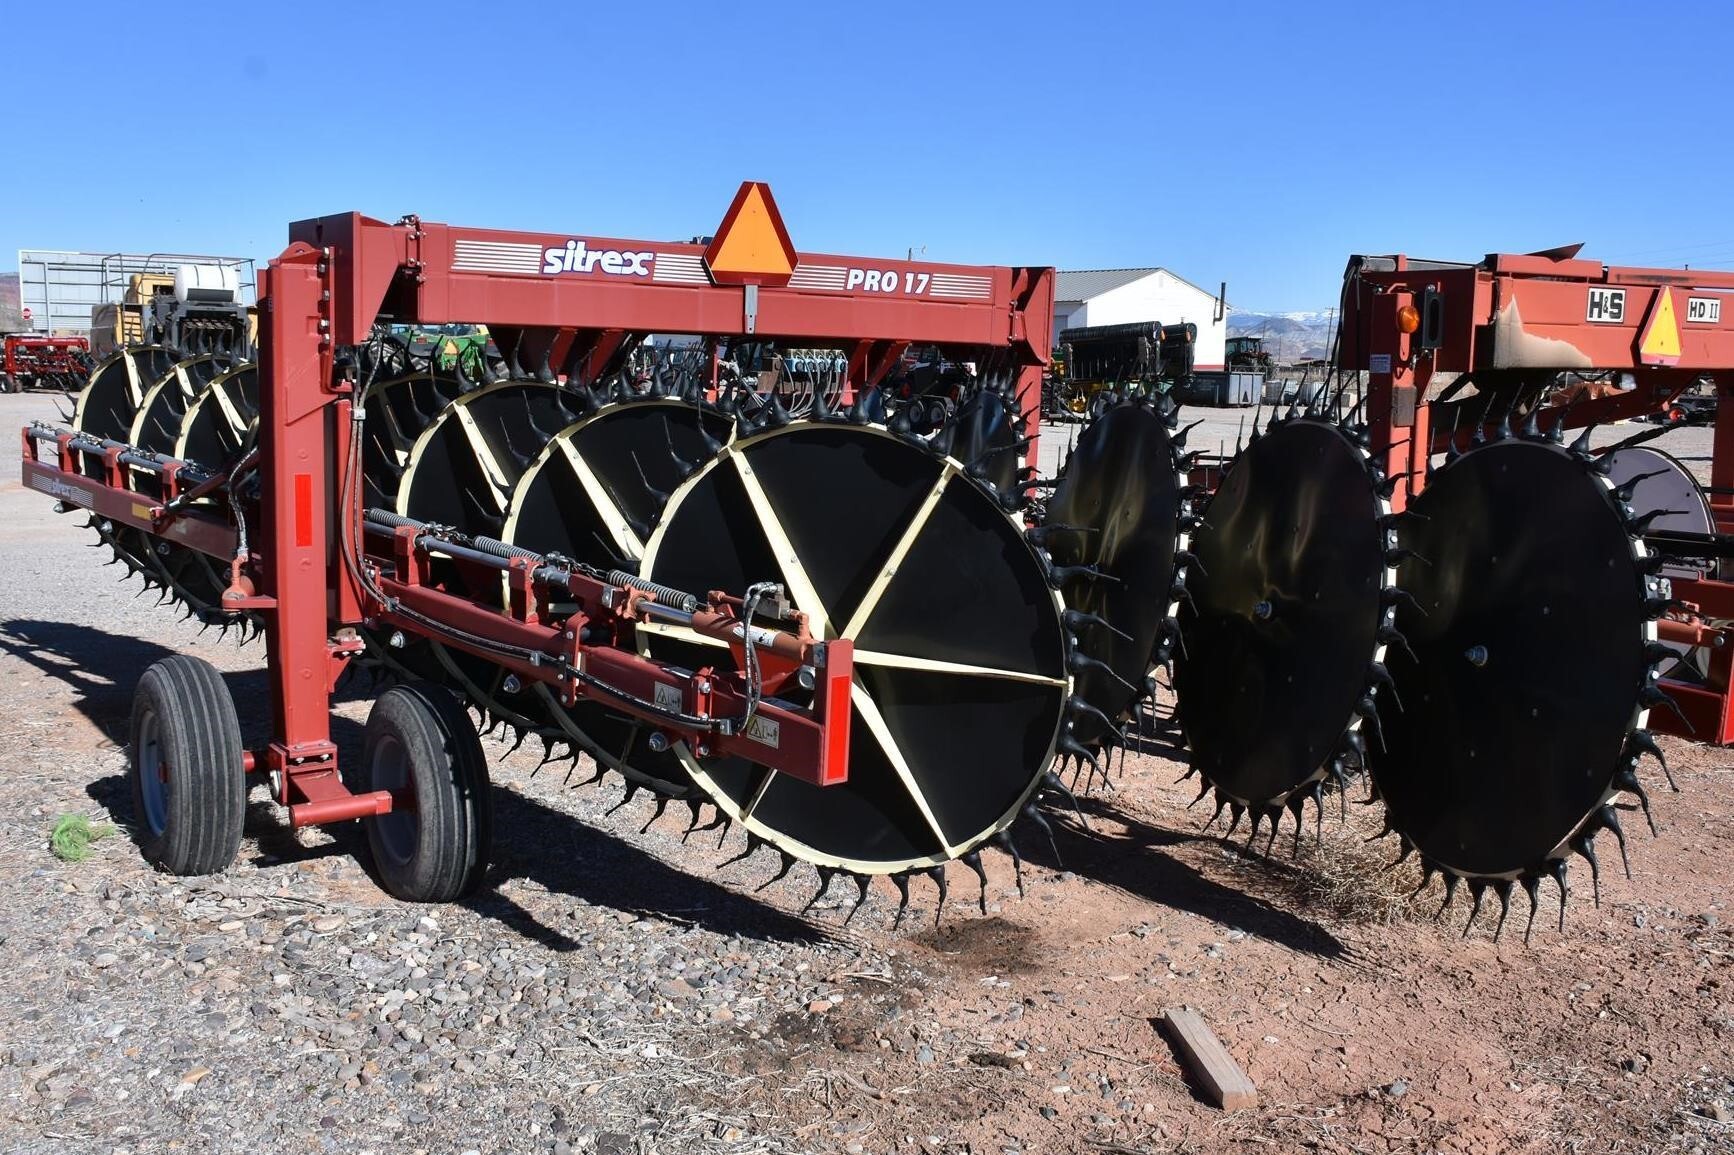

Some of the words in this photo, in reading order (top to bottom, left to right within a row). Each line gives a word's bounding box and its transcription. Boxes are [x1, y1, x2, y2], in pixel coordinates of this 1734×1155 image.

[543, 240, 654, 276] sitrex
[846, 268, 899, 293] PRO
[904, 272, 930, 294] 17
[1588, 291, 1624, 319] H&S
[1689, 301, 1706, 318] HD
